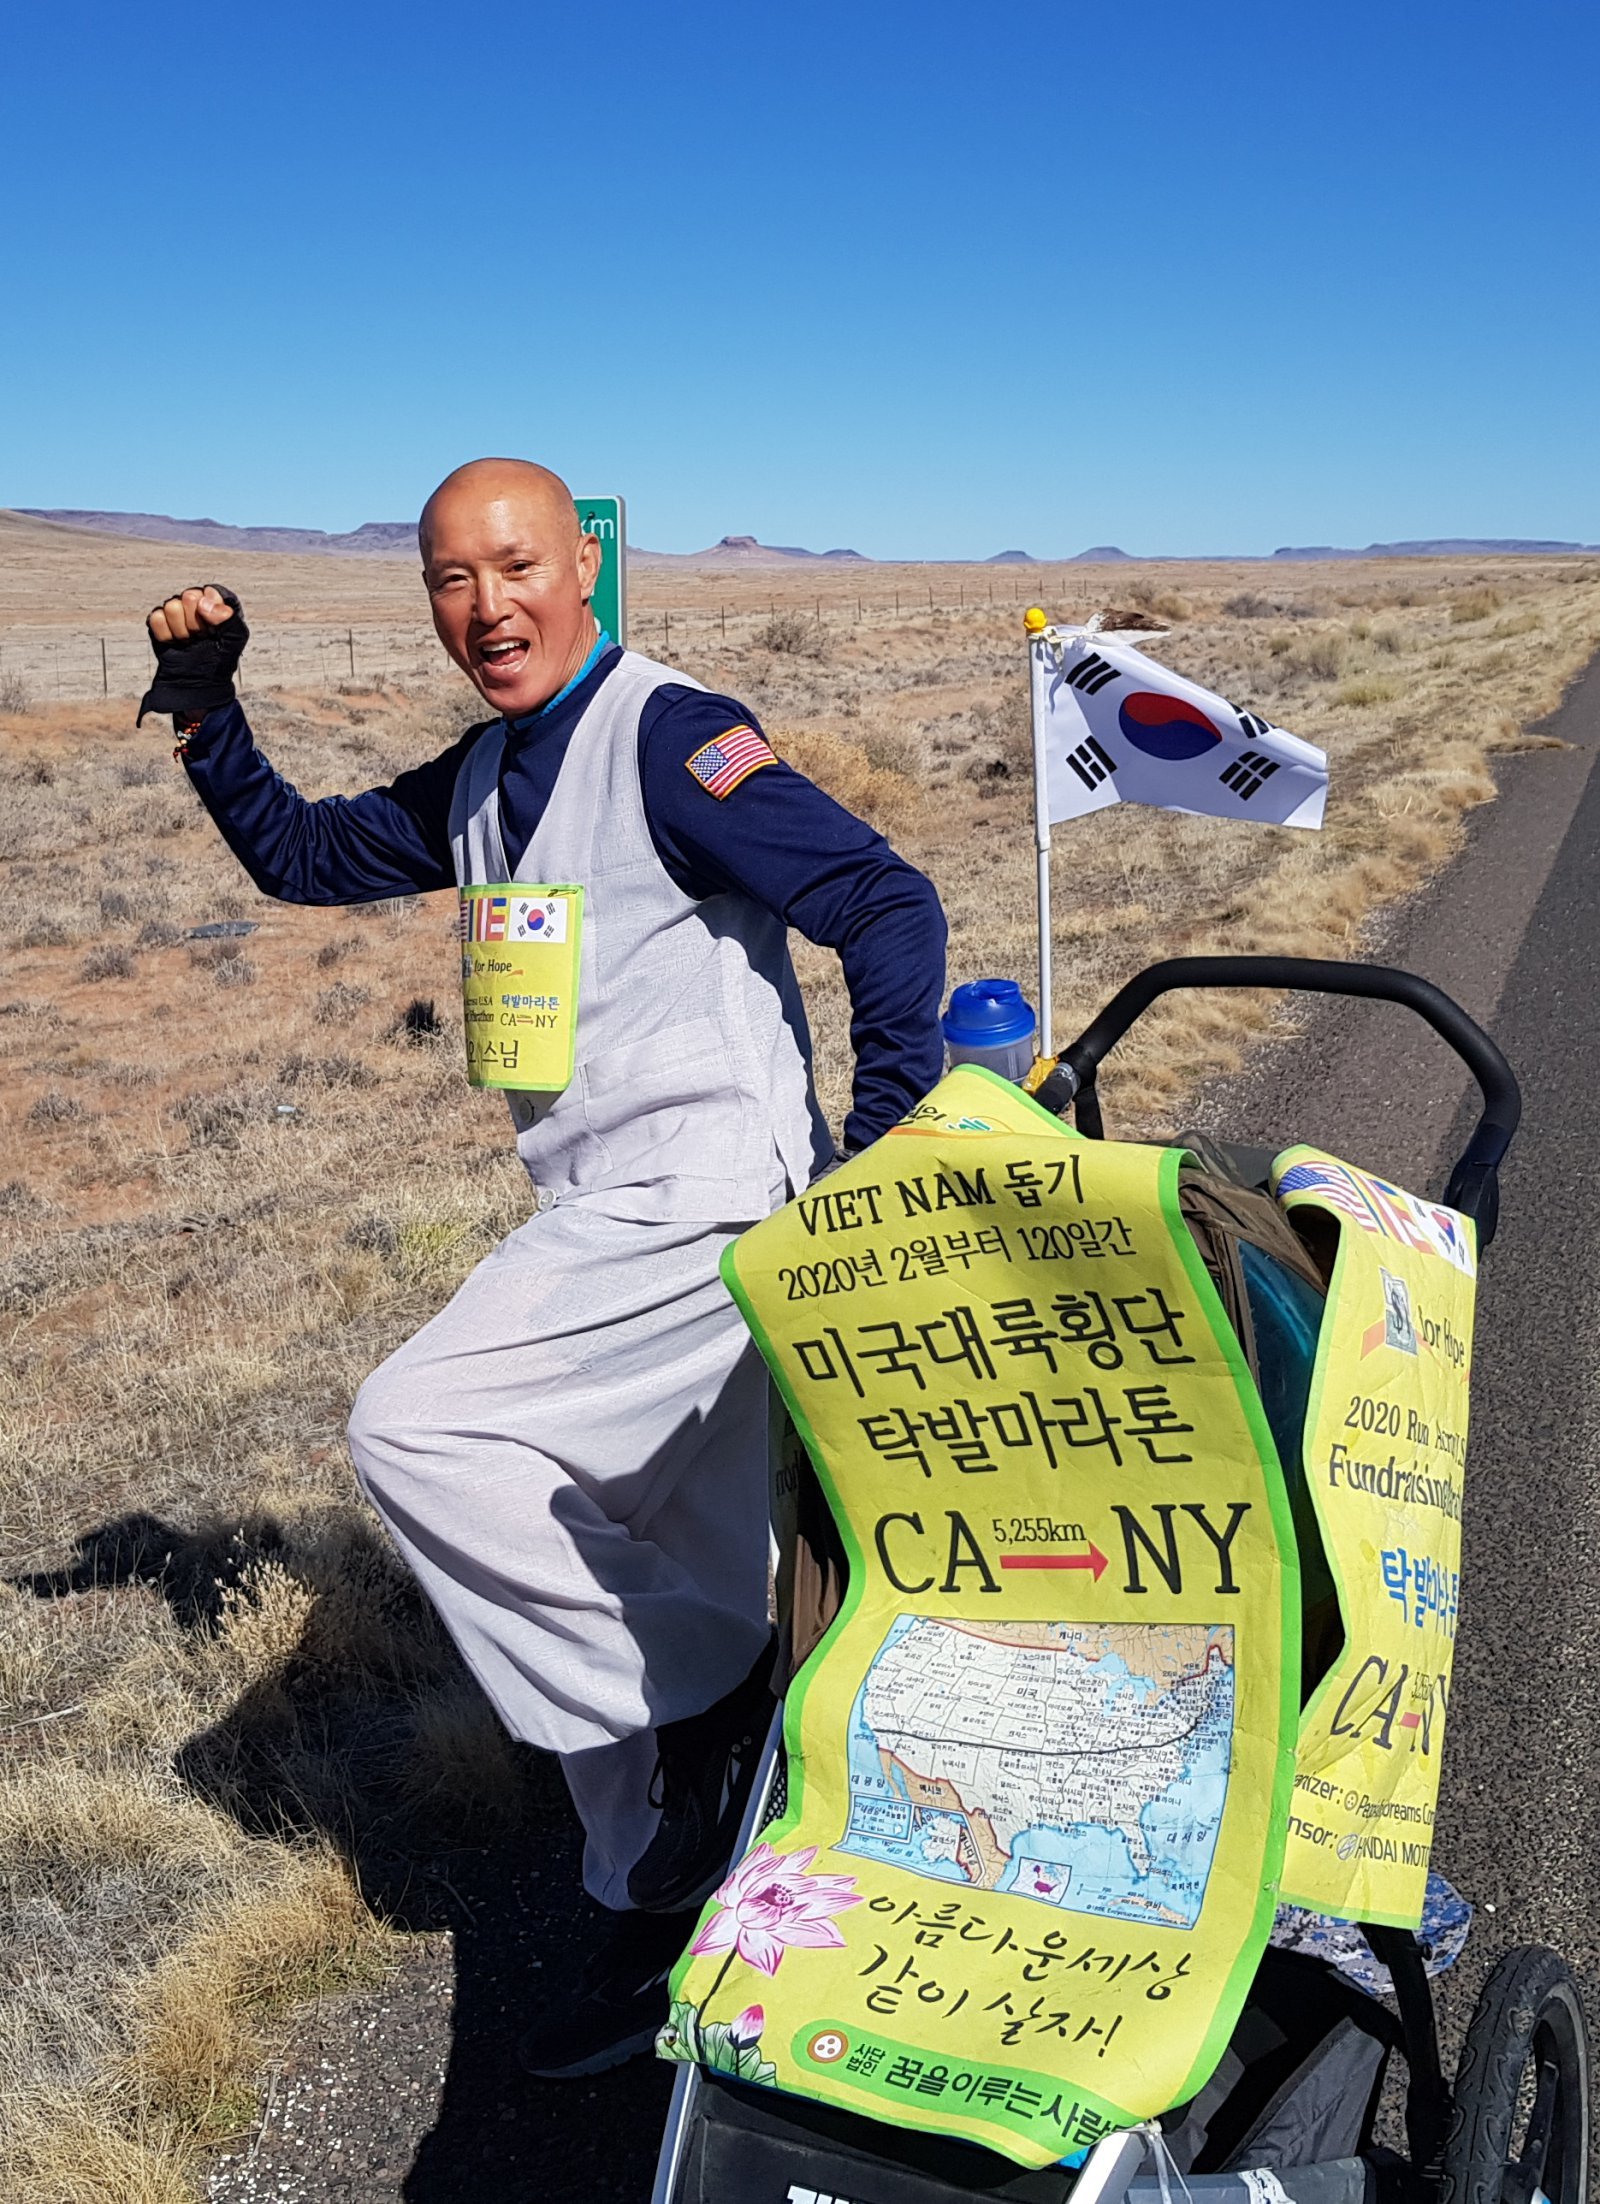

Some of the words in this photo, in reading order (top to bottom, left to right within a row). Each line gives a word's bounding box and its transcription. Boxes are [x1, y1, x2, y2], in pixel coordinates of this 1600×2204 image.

[488, 959, 512, 974] Hope
[501, 994, 560, 1011] 탁발마라톤
[536, 1014, 558, 1029] NY
[482, 1039, 519, 1069] 스님
[798, 1186, 883, 1236] VIET
[895, 1169, 996, 1217] NAM
[1003, 1154, 1084, 1209] 돕기
[779, 1248, 887, 1300] 2020년
[890, 1226, 1012, 1280] 2월부터
[1016, 1216, 1137, 1262] 120일간
[792, 1287, 1195, 1398] 미국대륙횡단
[857, 1385, 1194, 1478] 탁발마라톤
[1344, 1395, 1401, 1437] 2020
[874, 1511, 1002, 1594] CA
[992, 1518, 1087, 1544] 5,255km
[1111, 1502, 1252, 1595] NY
[1330, 1654, 1409, 1751] CA
[858, 1943, 969, 2018] 같이
[845, 2056, 878, 2078] 법인
[854, 2042, 887, 2065] 사단
